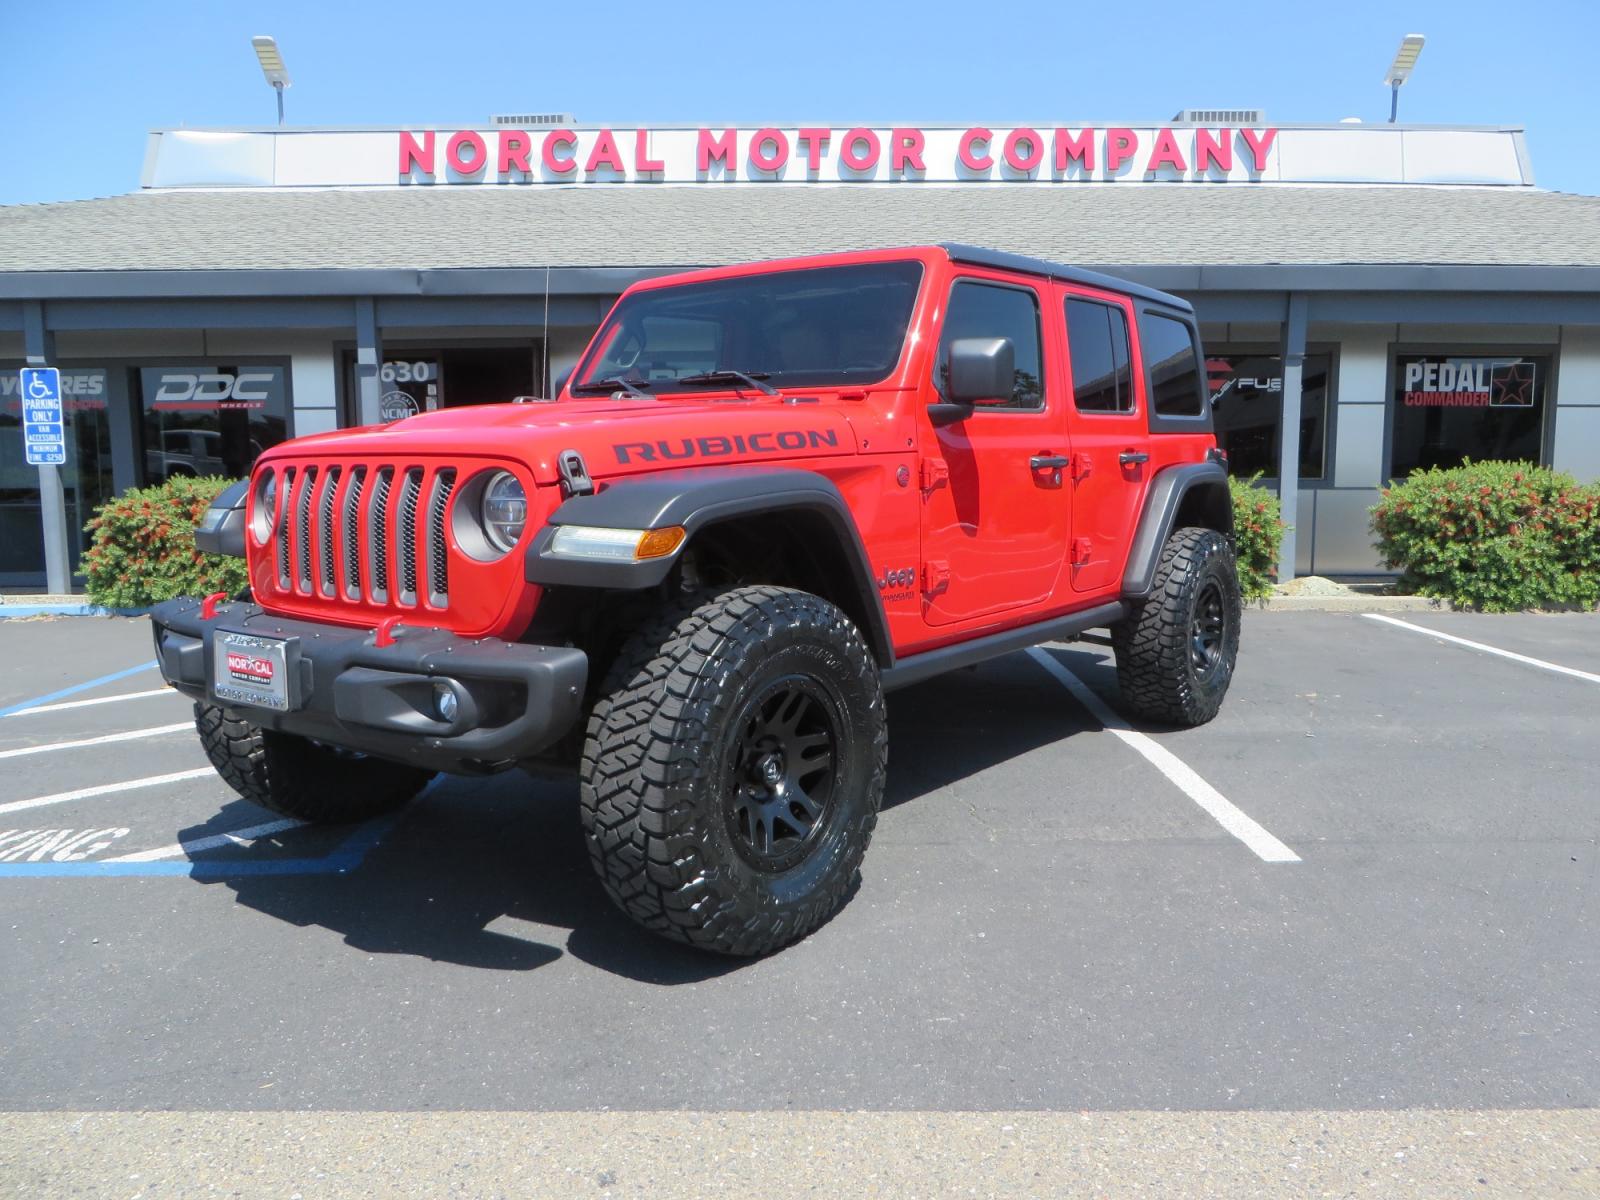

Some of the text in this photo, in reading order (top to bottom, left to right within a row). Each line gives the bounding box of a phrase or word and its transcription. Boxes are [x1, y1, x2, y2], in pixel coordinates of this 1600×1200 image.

[400, 127, 1278, 175] NORCAL MOTOR COMPANY
[381, 361, 429, 382] 630
[1405, 363, 1489, 392] PEDAL
[155, 374, 274, 401] DDC
[1404, 391, 1488, 406] COMMANDER
[25, 399, 59, 410] PARKING
[32, 411, 53, 422] ONLY
[612, 429, 839, 465] RUBICON
[878, 566, 914, 590] Jeep
